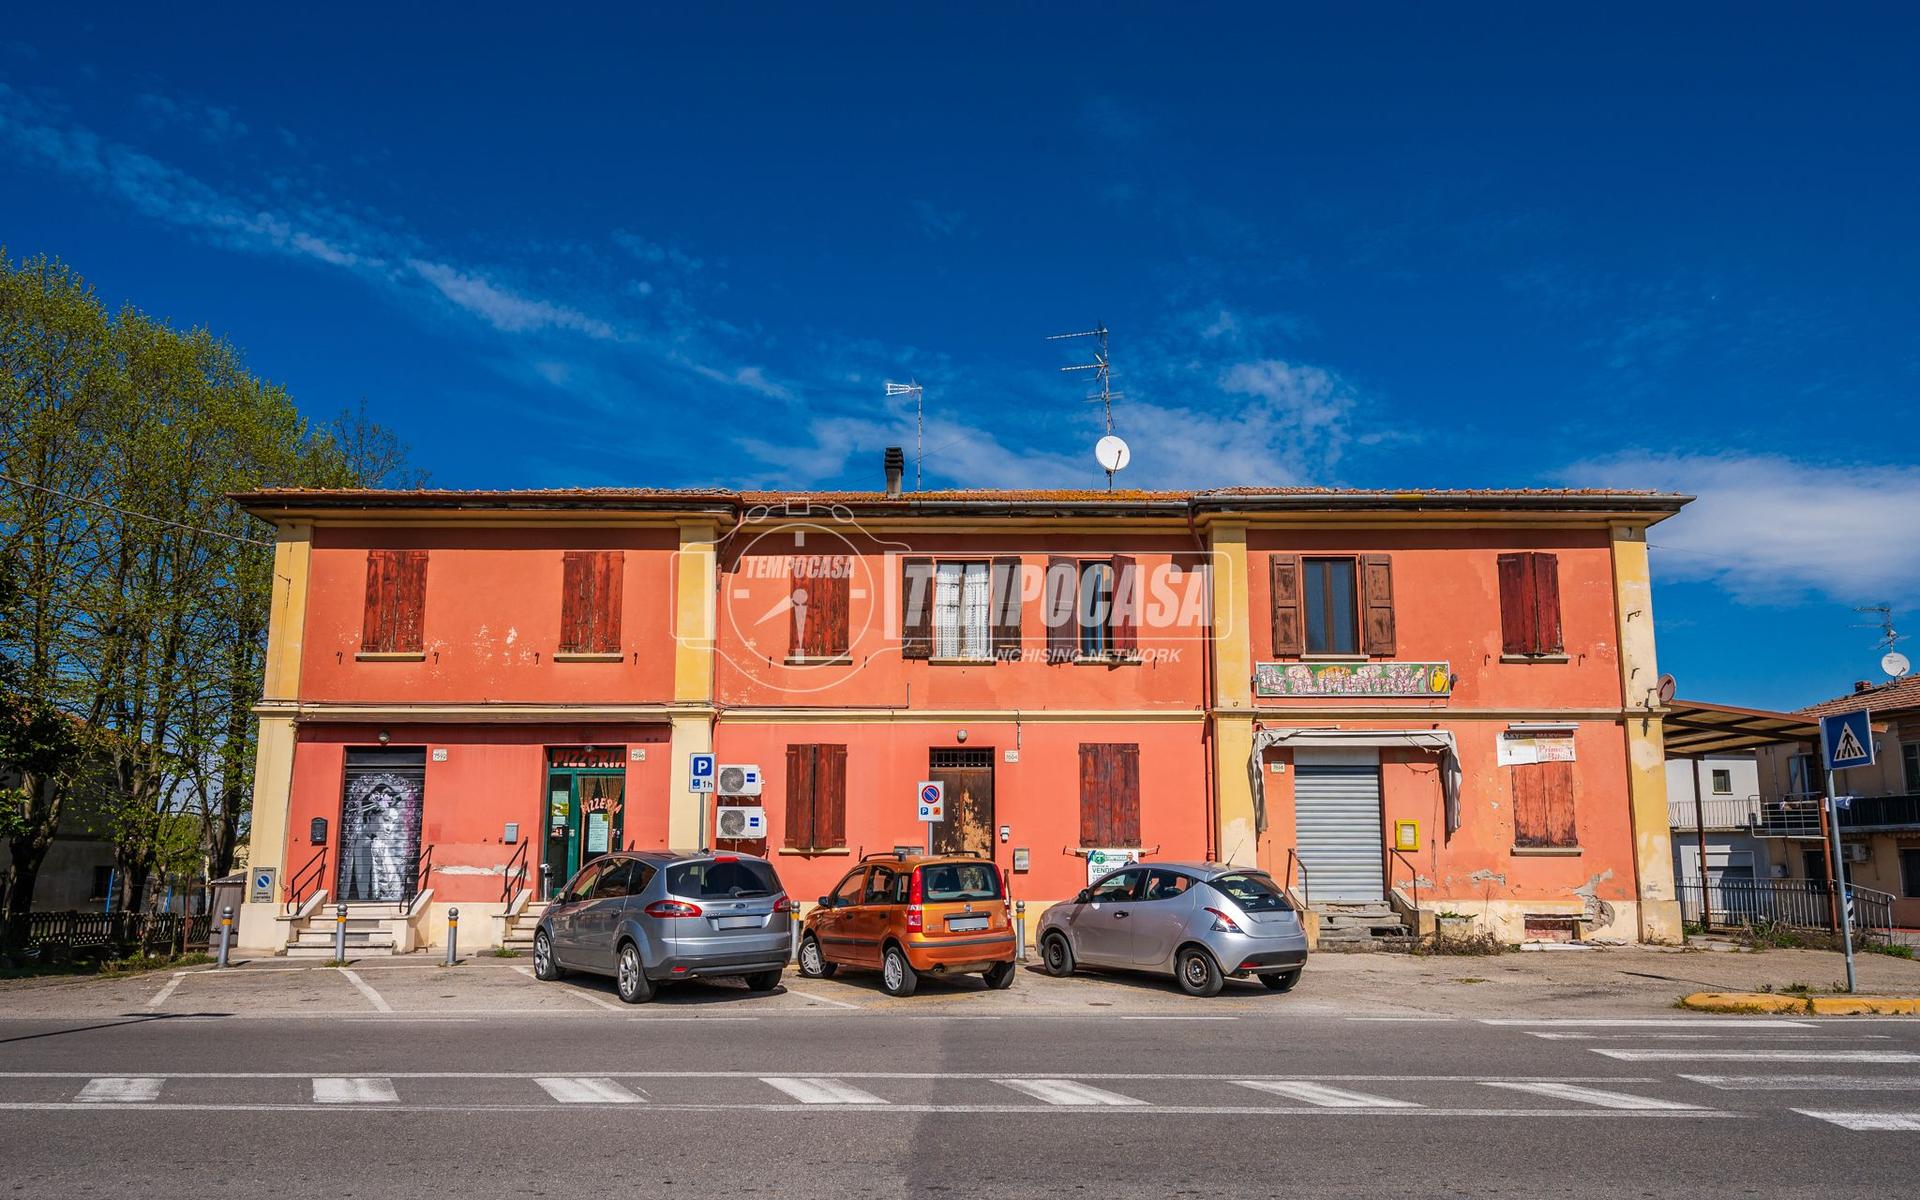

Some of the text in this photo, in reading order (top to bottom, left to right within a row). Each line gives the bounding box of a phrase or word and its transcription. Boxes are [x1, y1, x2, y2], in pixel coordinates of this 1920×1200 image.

[553, 750, 626, 768] PIZZERIA
[697, 760, 709, 774] P
[1092, 866, 1120, 874] VENDIT
